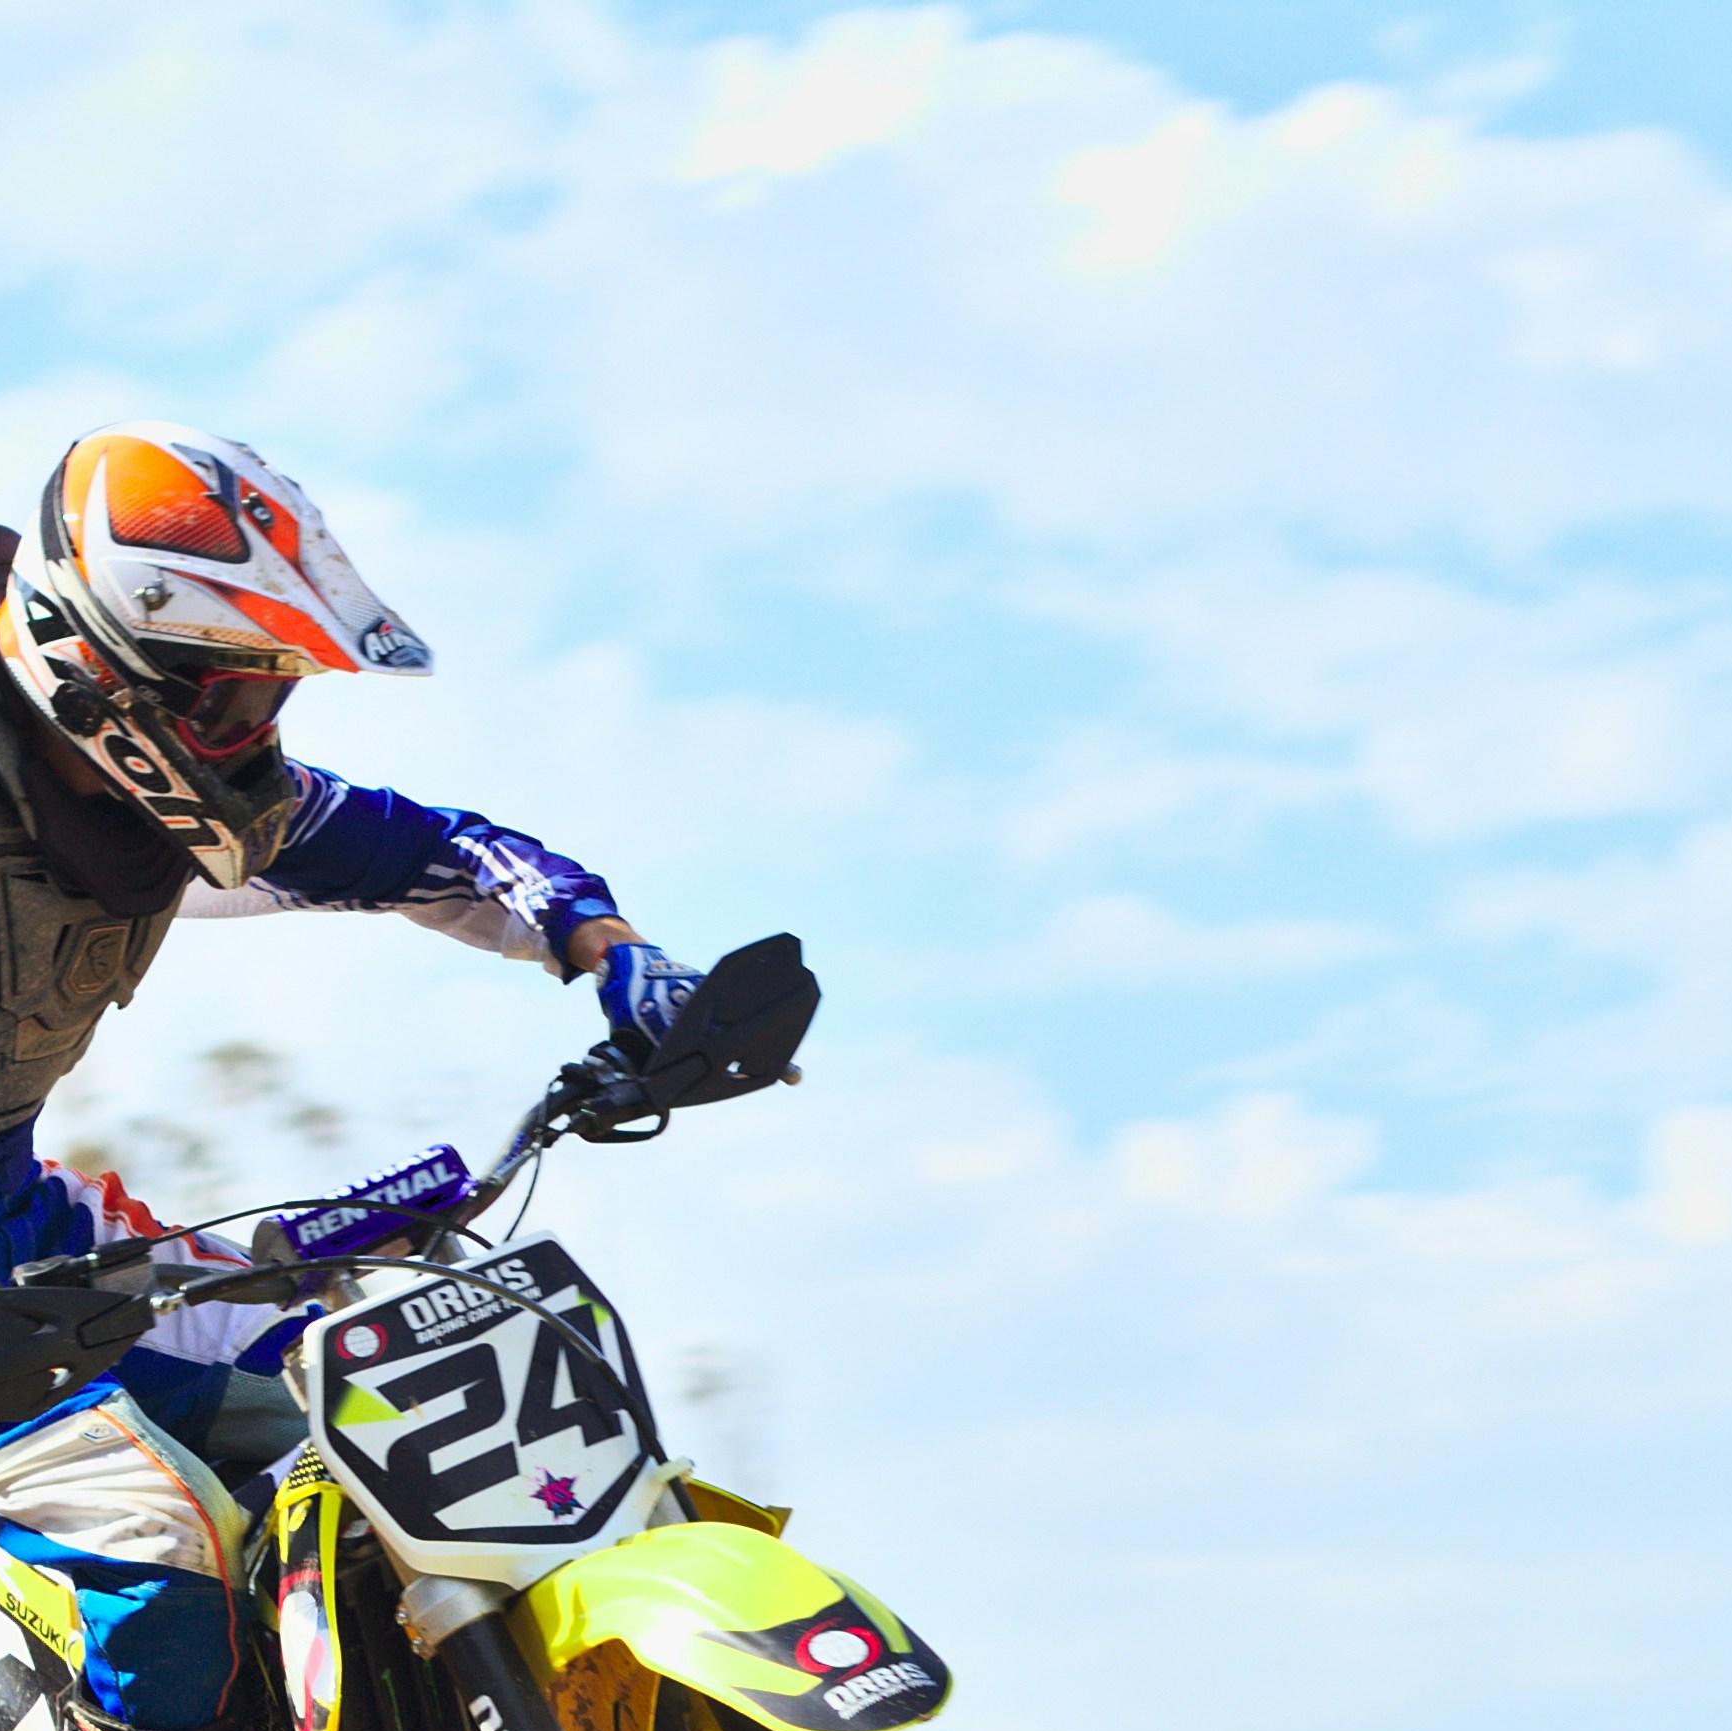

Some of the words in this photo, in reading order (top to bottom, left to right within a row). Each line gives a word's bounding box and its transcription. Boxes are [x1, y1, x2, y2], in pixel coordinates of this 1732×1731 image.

[296, 1161, 460, 1247] RENTHAL
[375, 1303, 624, 1513] 24
[6, 1592, 66, 1653] SUZUKI
